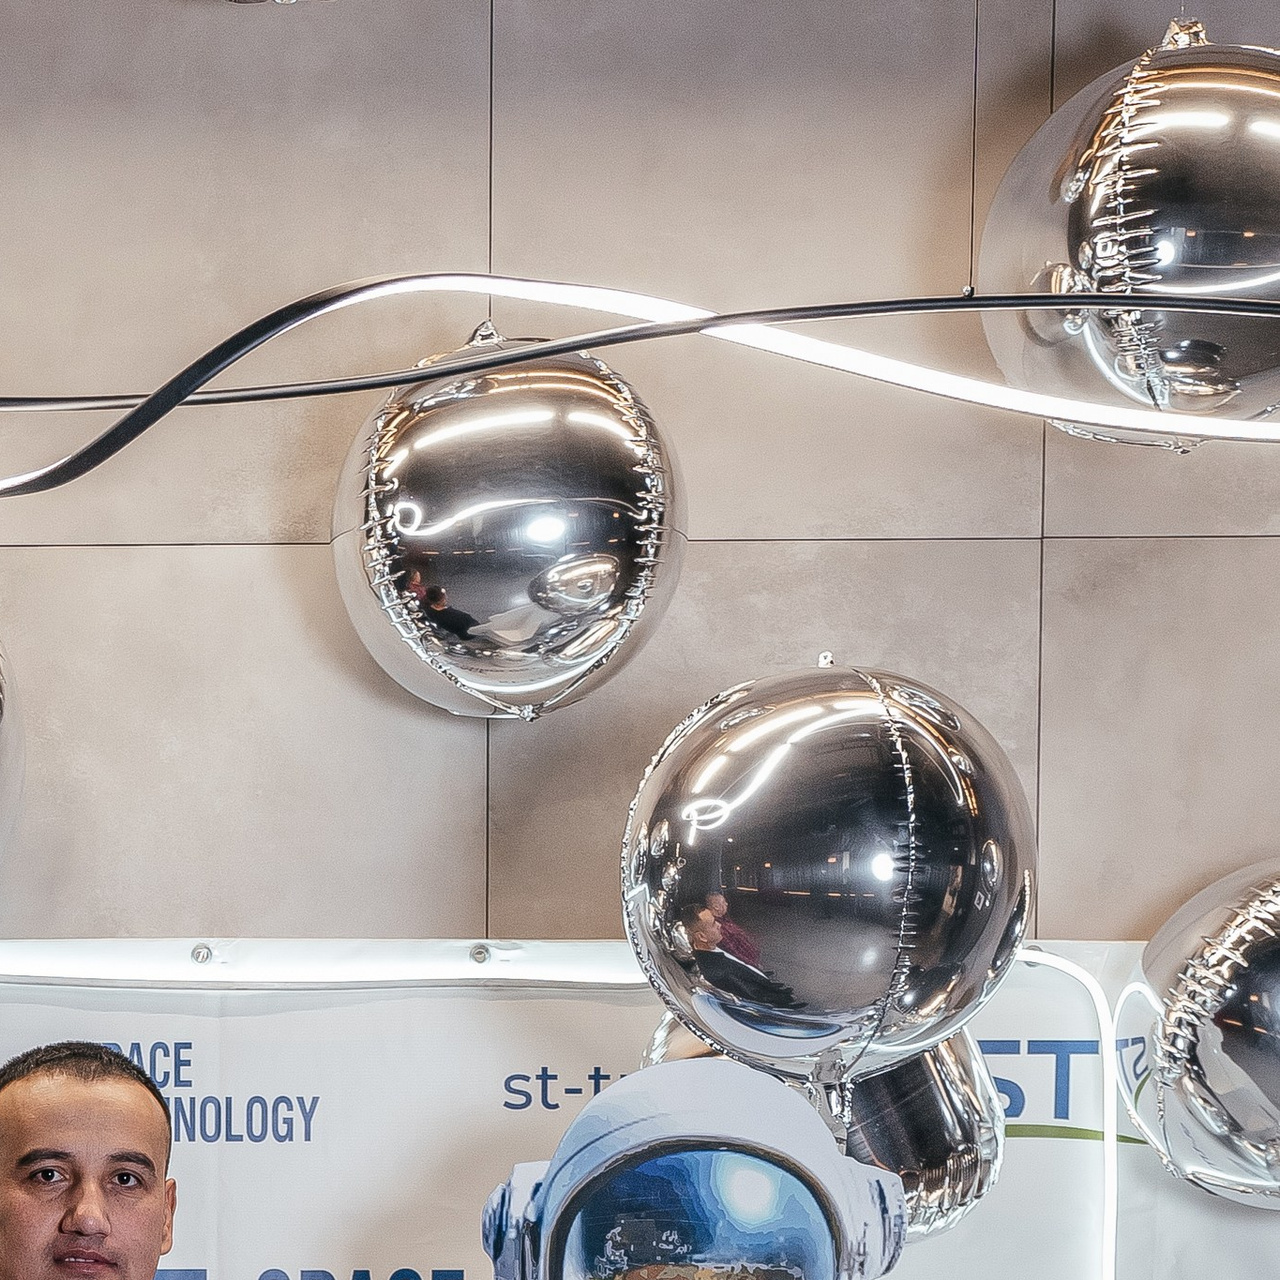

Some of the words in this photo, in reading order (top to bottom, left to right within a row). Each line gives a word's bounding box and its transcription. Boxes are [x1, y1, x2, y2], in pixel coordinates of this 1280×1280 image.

[102, 1041, 193, 1088] ACE
[503, 1066, 628, 1110] st-t
[166, 1096, 320, 1142] NOLOGY
